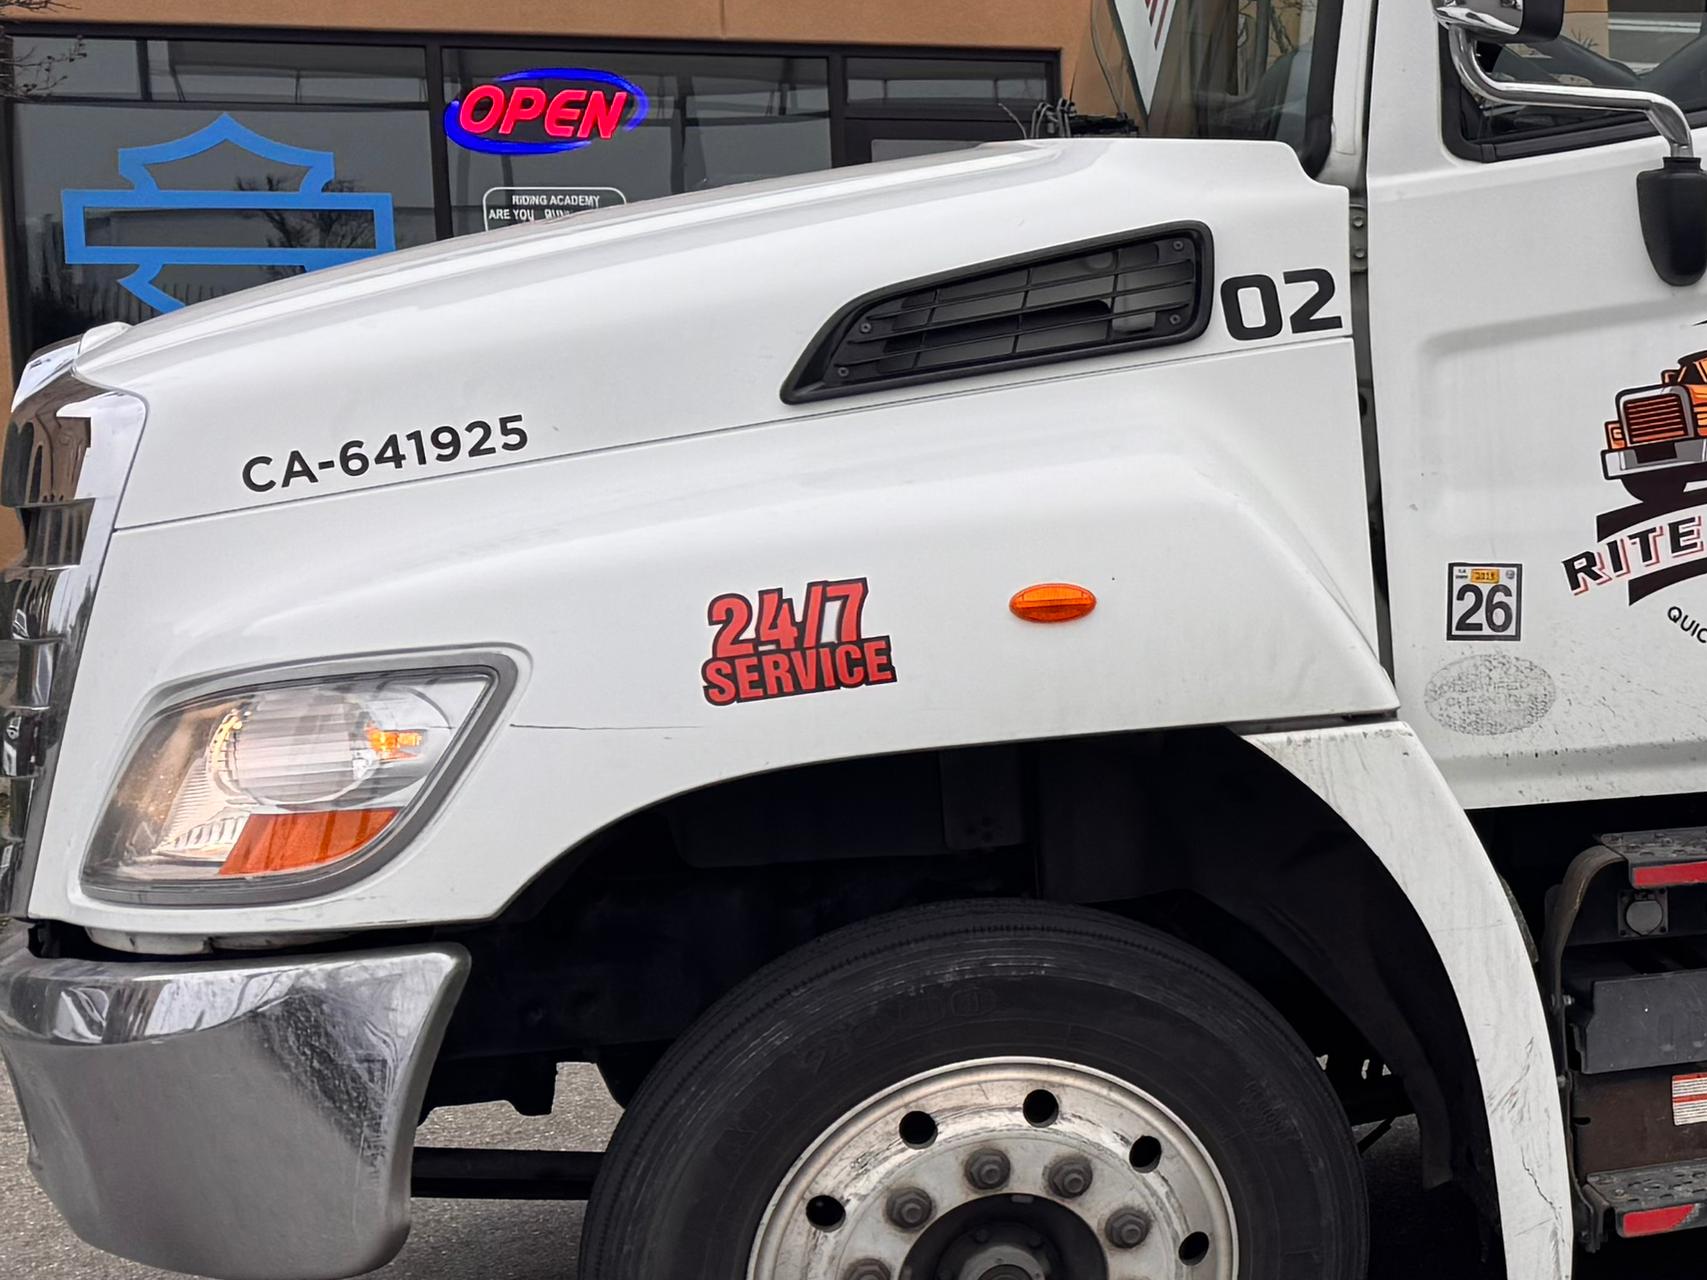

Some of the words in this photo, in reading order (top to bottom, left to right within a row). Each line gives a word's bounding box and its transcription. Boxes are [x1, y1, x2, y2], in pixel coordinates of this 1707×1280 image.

[460, 85, 627, 139] OPEN
[488, 209, 510, 219] ARE
[513, 209, 534, 221] YOU
[512, 195, 547, 205] RIDING
[549, 195, 600, 208] ACADEMY
[1220, 268, 1343, 341] 02
[242, 414, 528, 492] CA-641925
[1561, 515, 1703, 595] RITE
[708, 578, 868, 658] 24/7
[1455, 584, 1513, 633] 26
[702, 637, 897, 705] SERVICE
